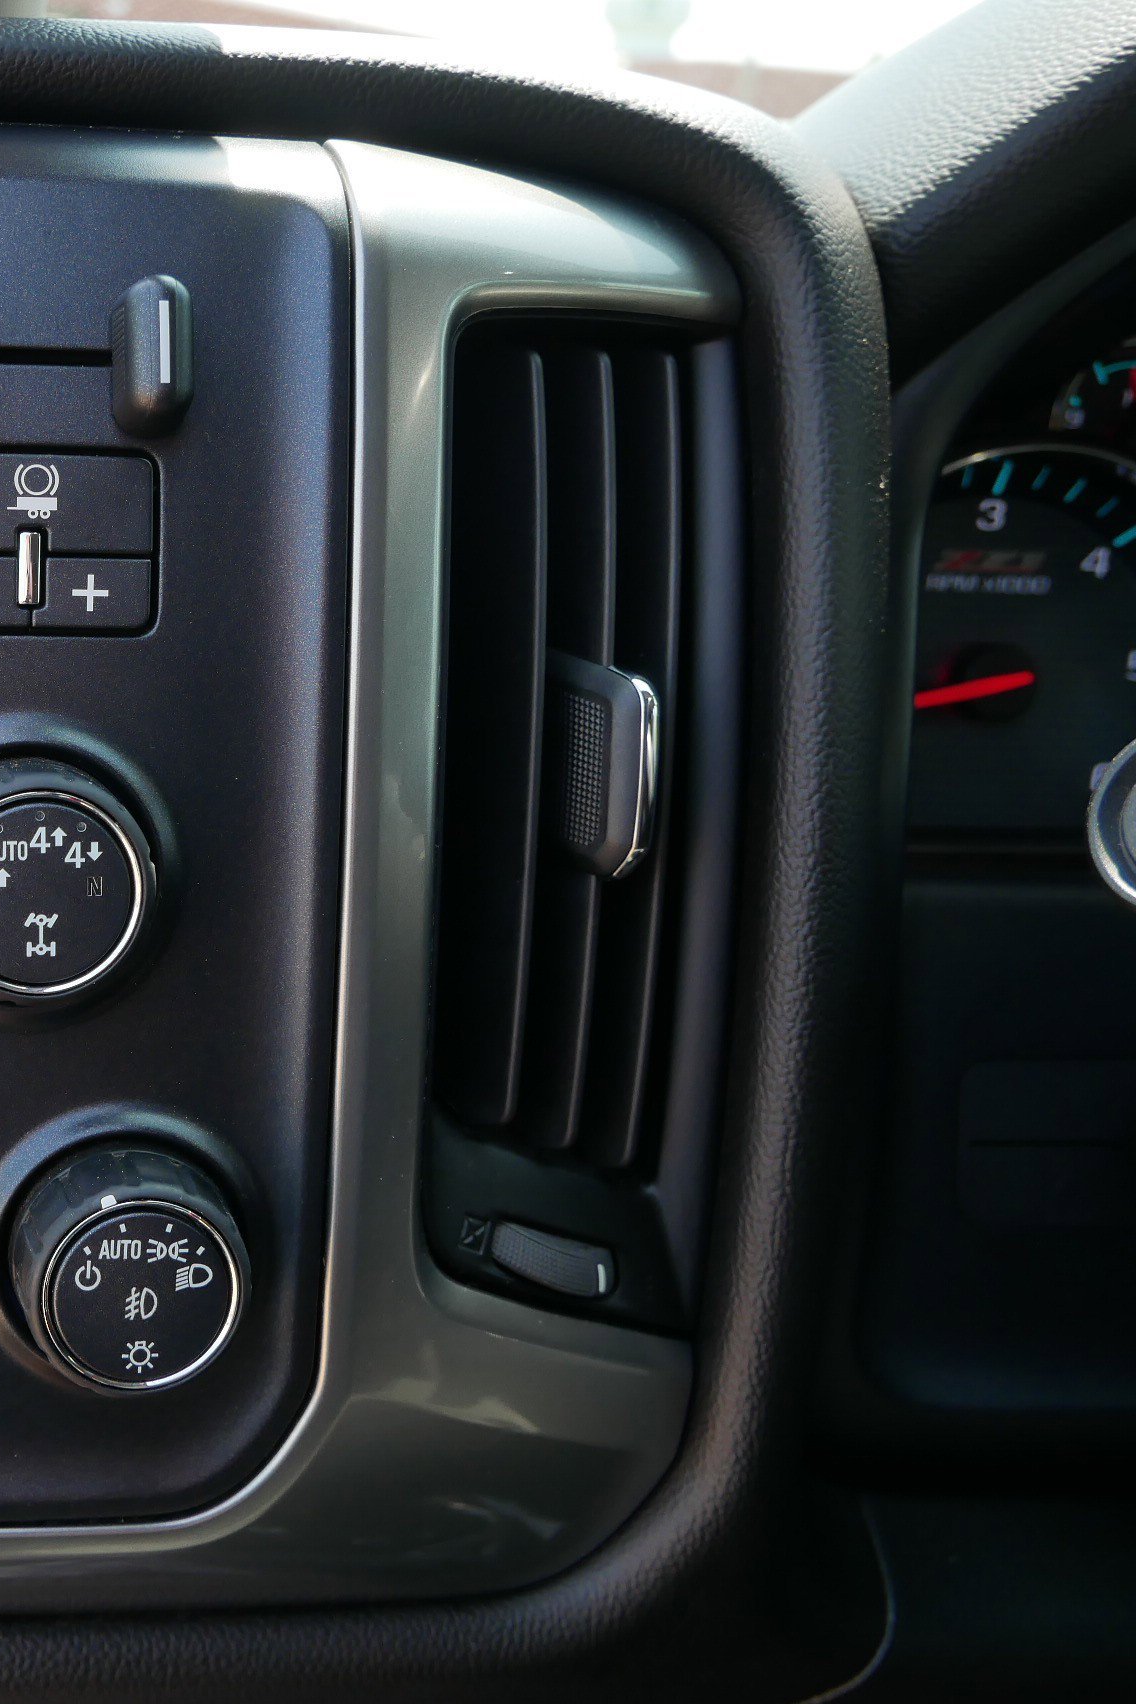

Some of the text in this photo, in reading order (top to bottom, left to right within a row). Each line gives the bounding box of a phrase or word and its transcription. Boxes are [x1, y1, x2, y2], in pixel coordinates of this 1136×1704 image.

[975, 498, 1008, 532] 3
[1080, 546, 1112, 580] 4
[29, 826, 51, 854] 4
[64, 841, 86, 869] 4
[86, 876, 103, 897] N
[98, 1239, 142, 1260] AUTO
